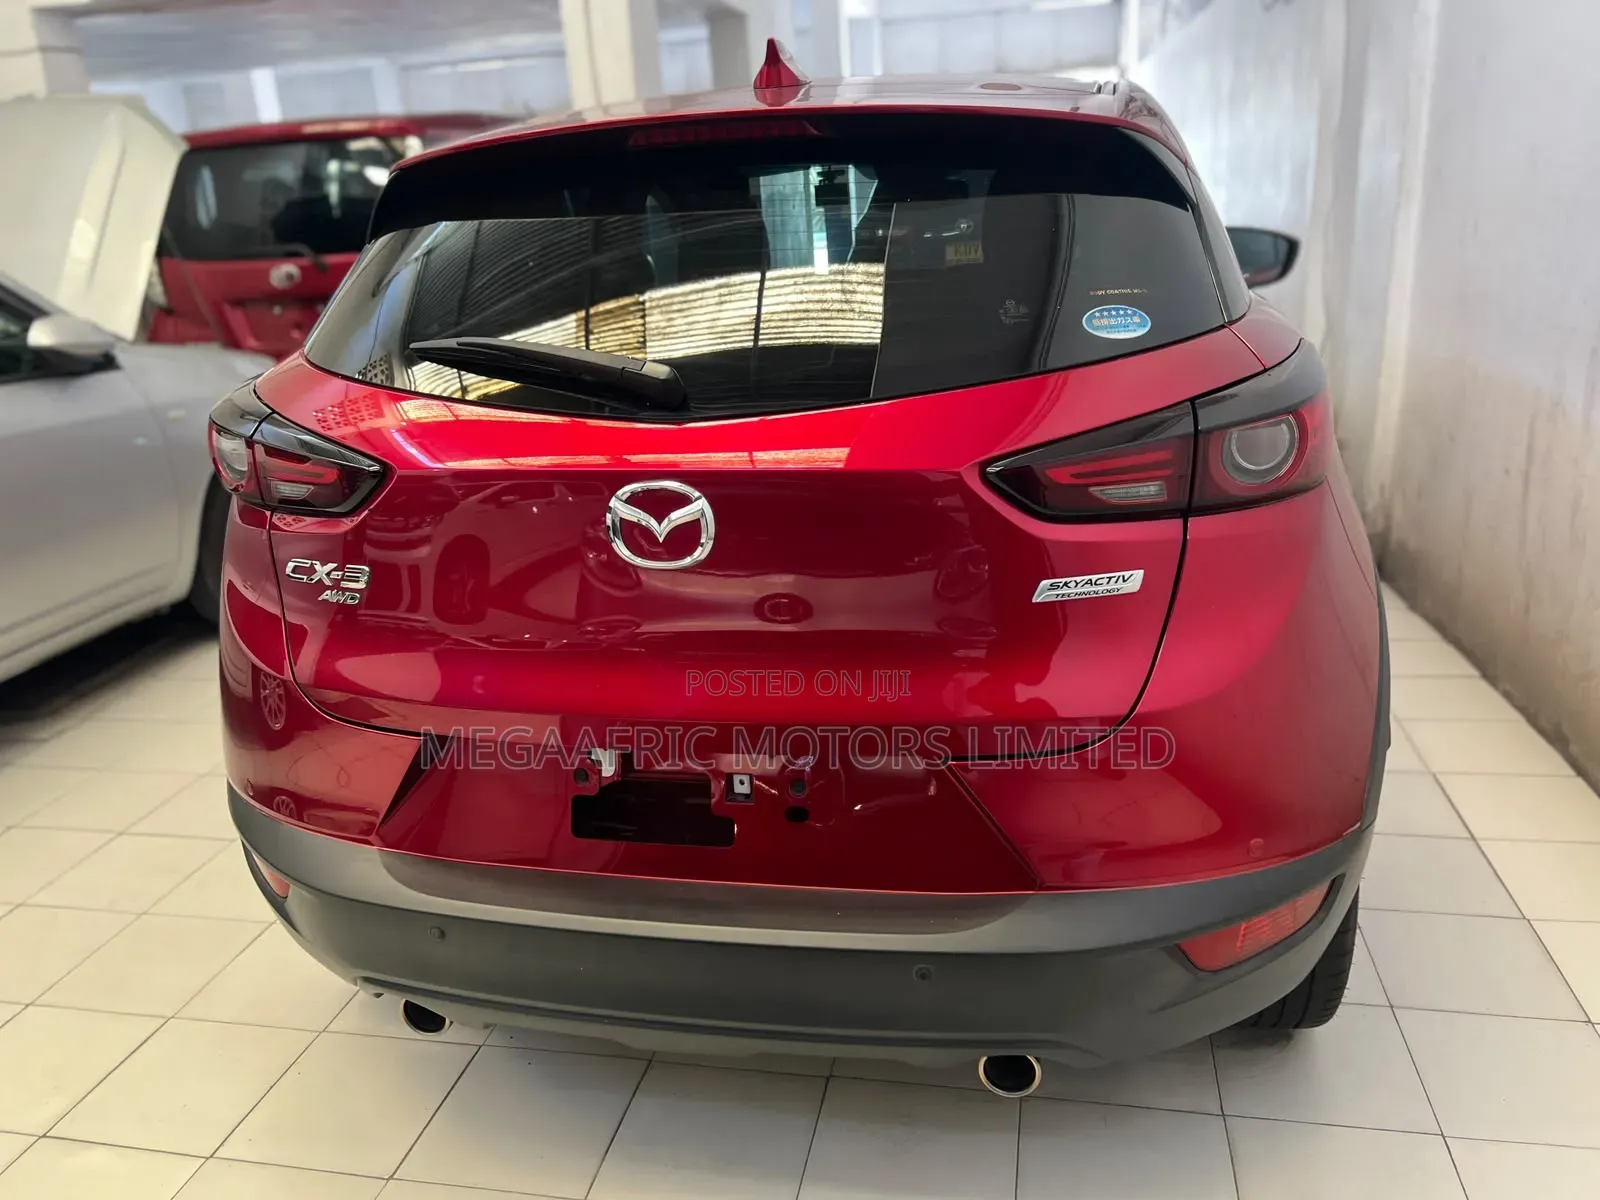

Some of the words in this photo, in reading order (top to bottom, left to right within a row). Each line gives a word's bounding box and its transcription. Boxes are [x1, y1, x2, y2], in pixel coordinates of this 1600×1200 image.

[285, 558, 370, 589] CX-3
[1047, 573, 1134, 591] SKYACTIV
[318, 589, 360, 605] AWD
[1054, 587, 1123, 599] TECHNOLOGY
